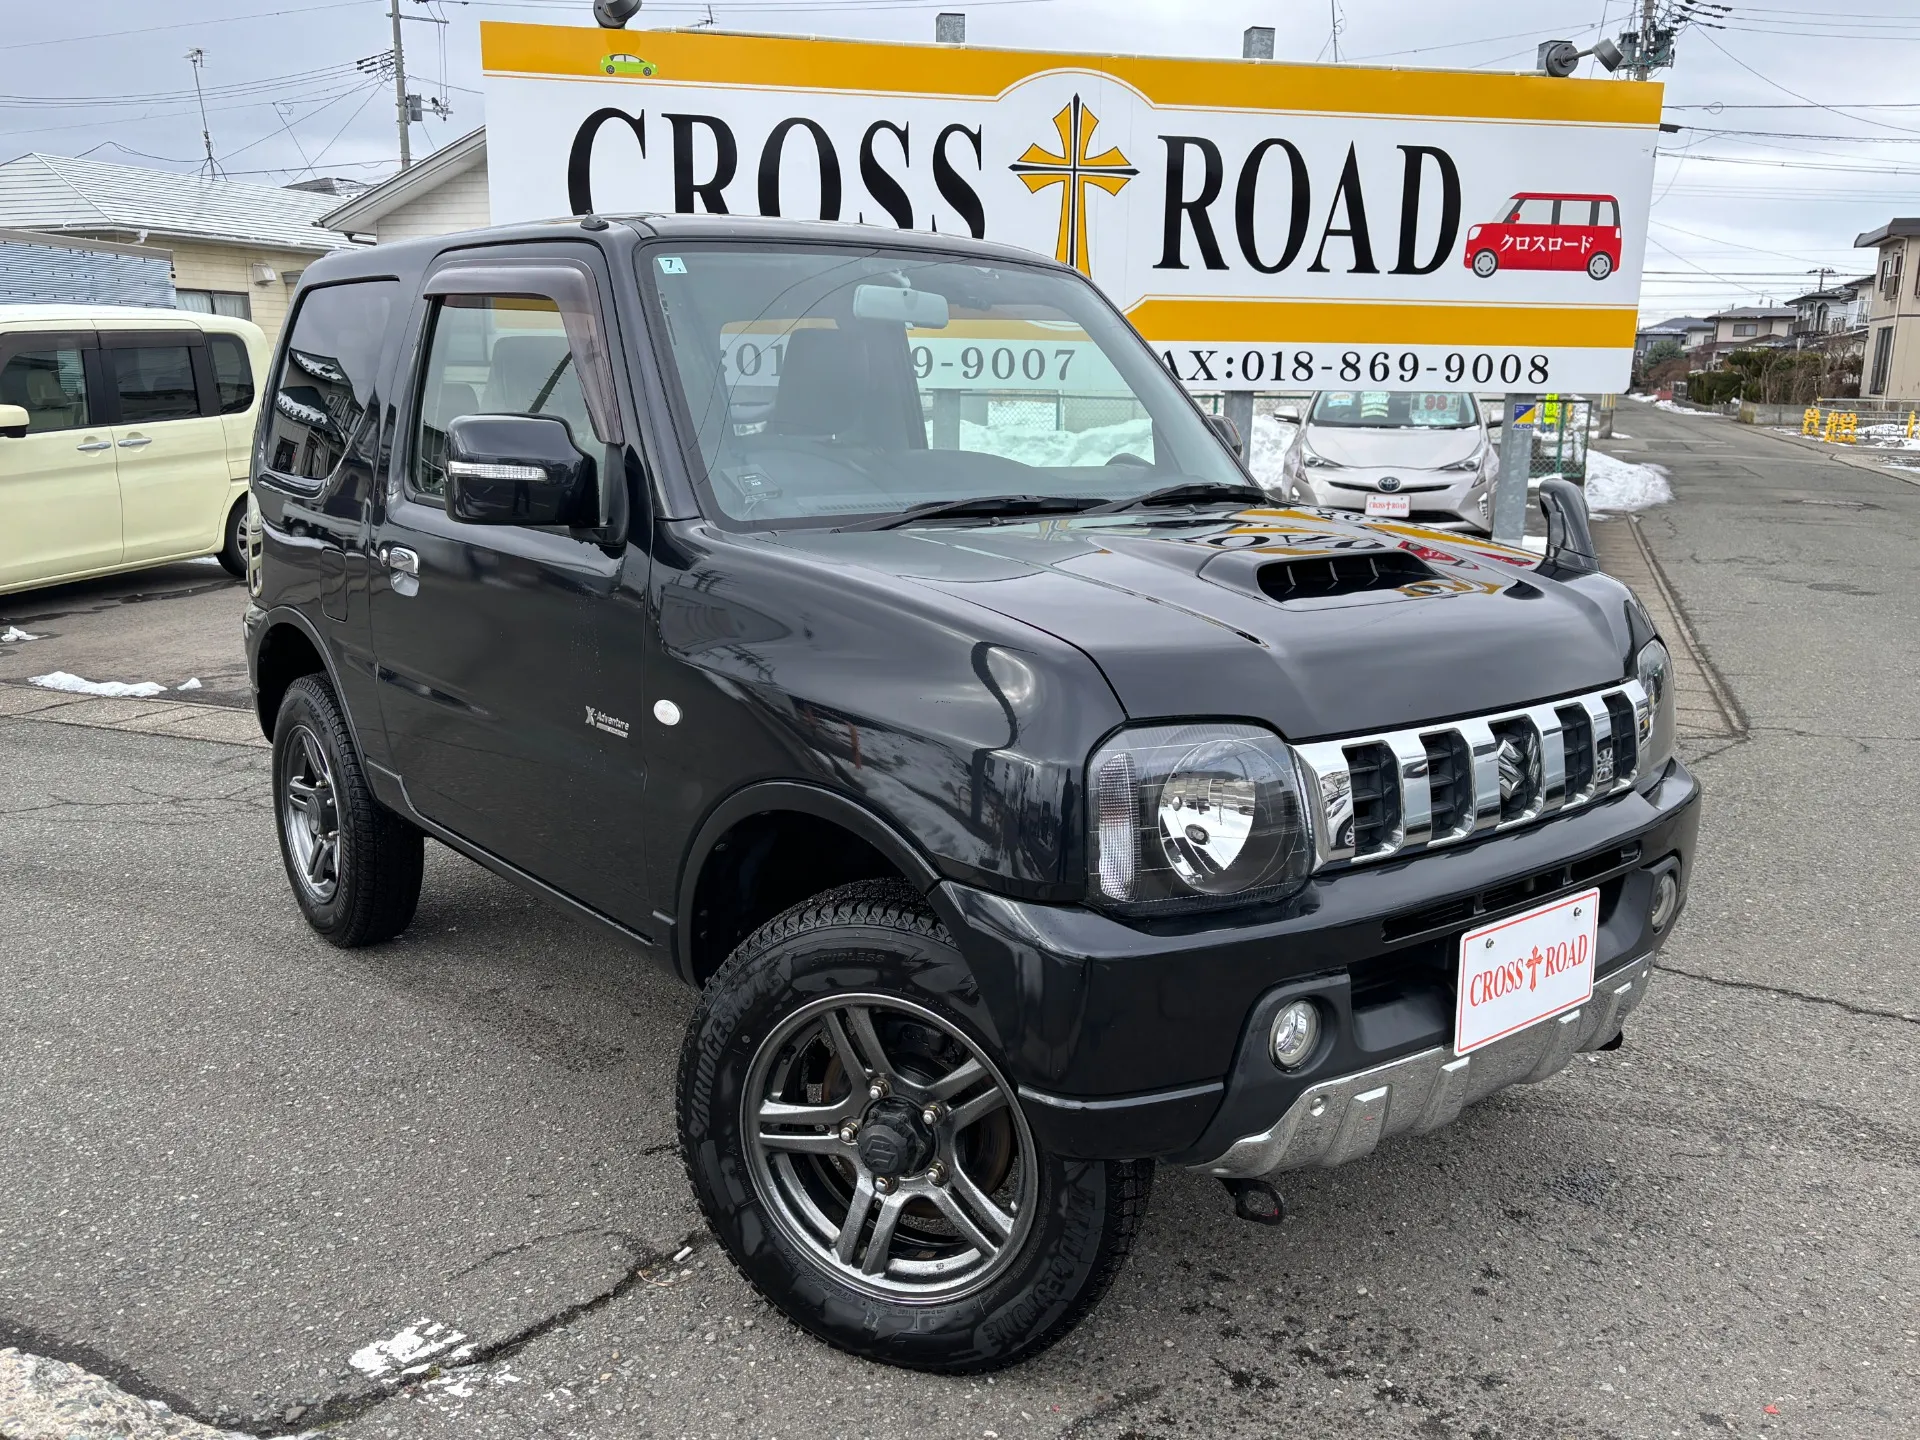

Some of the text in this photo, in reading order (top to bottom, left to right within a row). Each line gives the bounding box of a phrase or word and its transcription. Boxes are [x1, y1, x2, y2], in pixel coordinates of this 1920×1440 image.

[567, 107, 1462, 275] CROSS ROAD
[1500, 234, 1594, 254] クロスロード
[1161, 349, 1550, 384] AX:018-869-9008
[811, 952, 886, 967] STUDLESS
[1470, 934, 1588, 1007] CROSS ROAD
